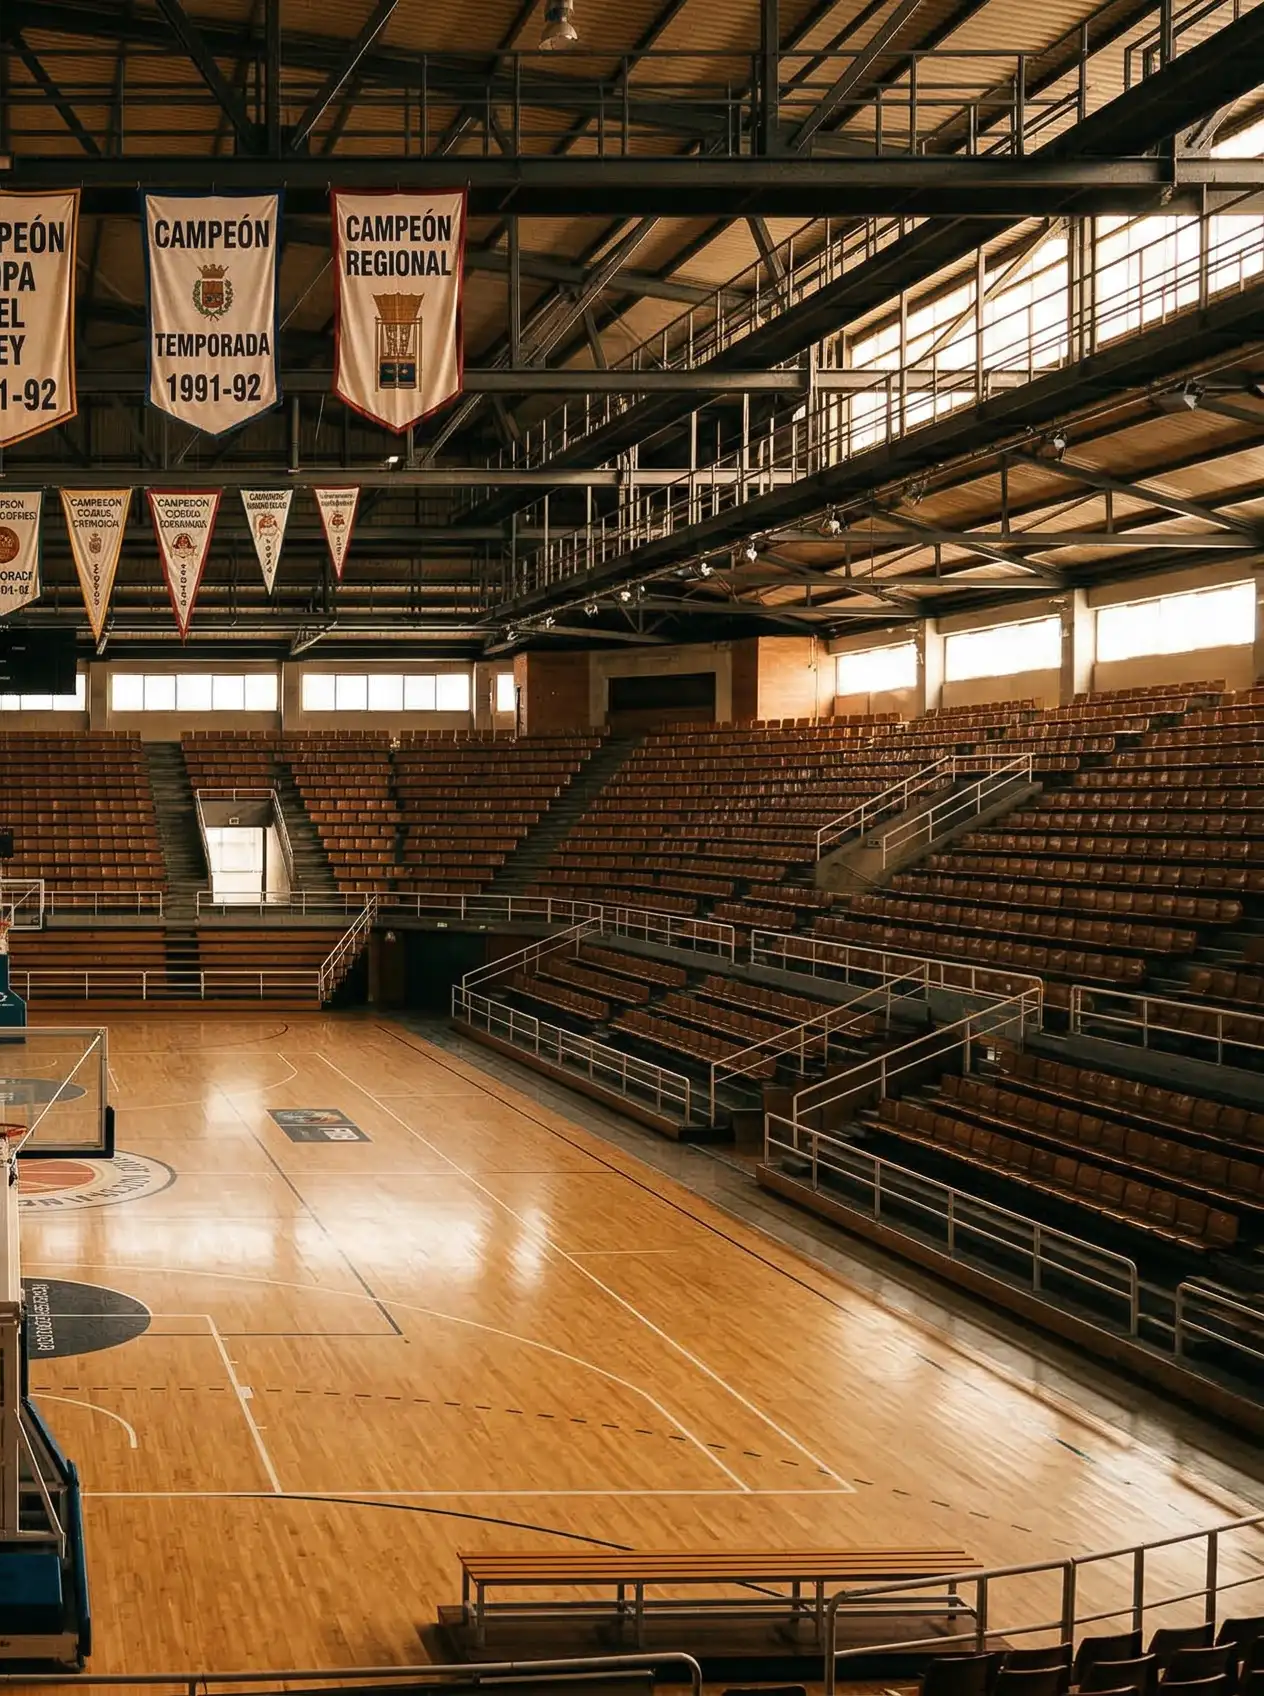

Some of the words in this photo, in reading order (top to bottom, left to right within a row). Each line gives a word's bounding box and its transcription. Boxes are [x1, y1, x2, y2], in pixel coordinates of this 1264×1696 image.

[154, 215, 270, 249] CAMPEÓN
[345, 208, 452, 242] CAMPEÓN
[345, 250, 452, 277] REGIONAL
[154, 332, 271, 358] TEMPORADA
[166, 373, 262, 402] 1991-92
